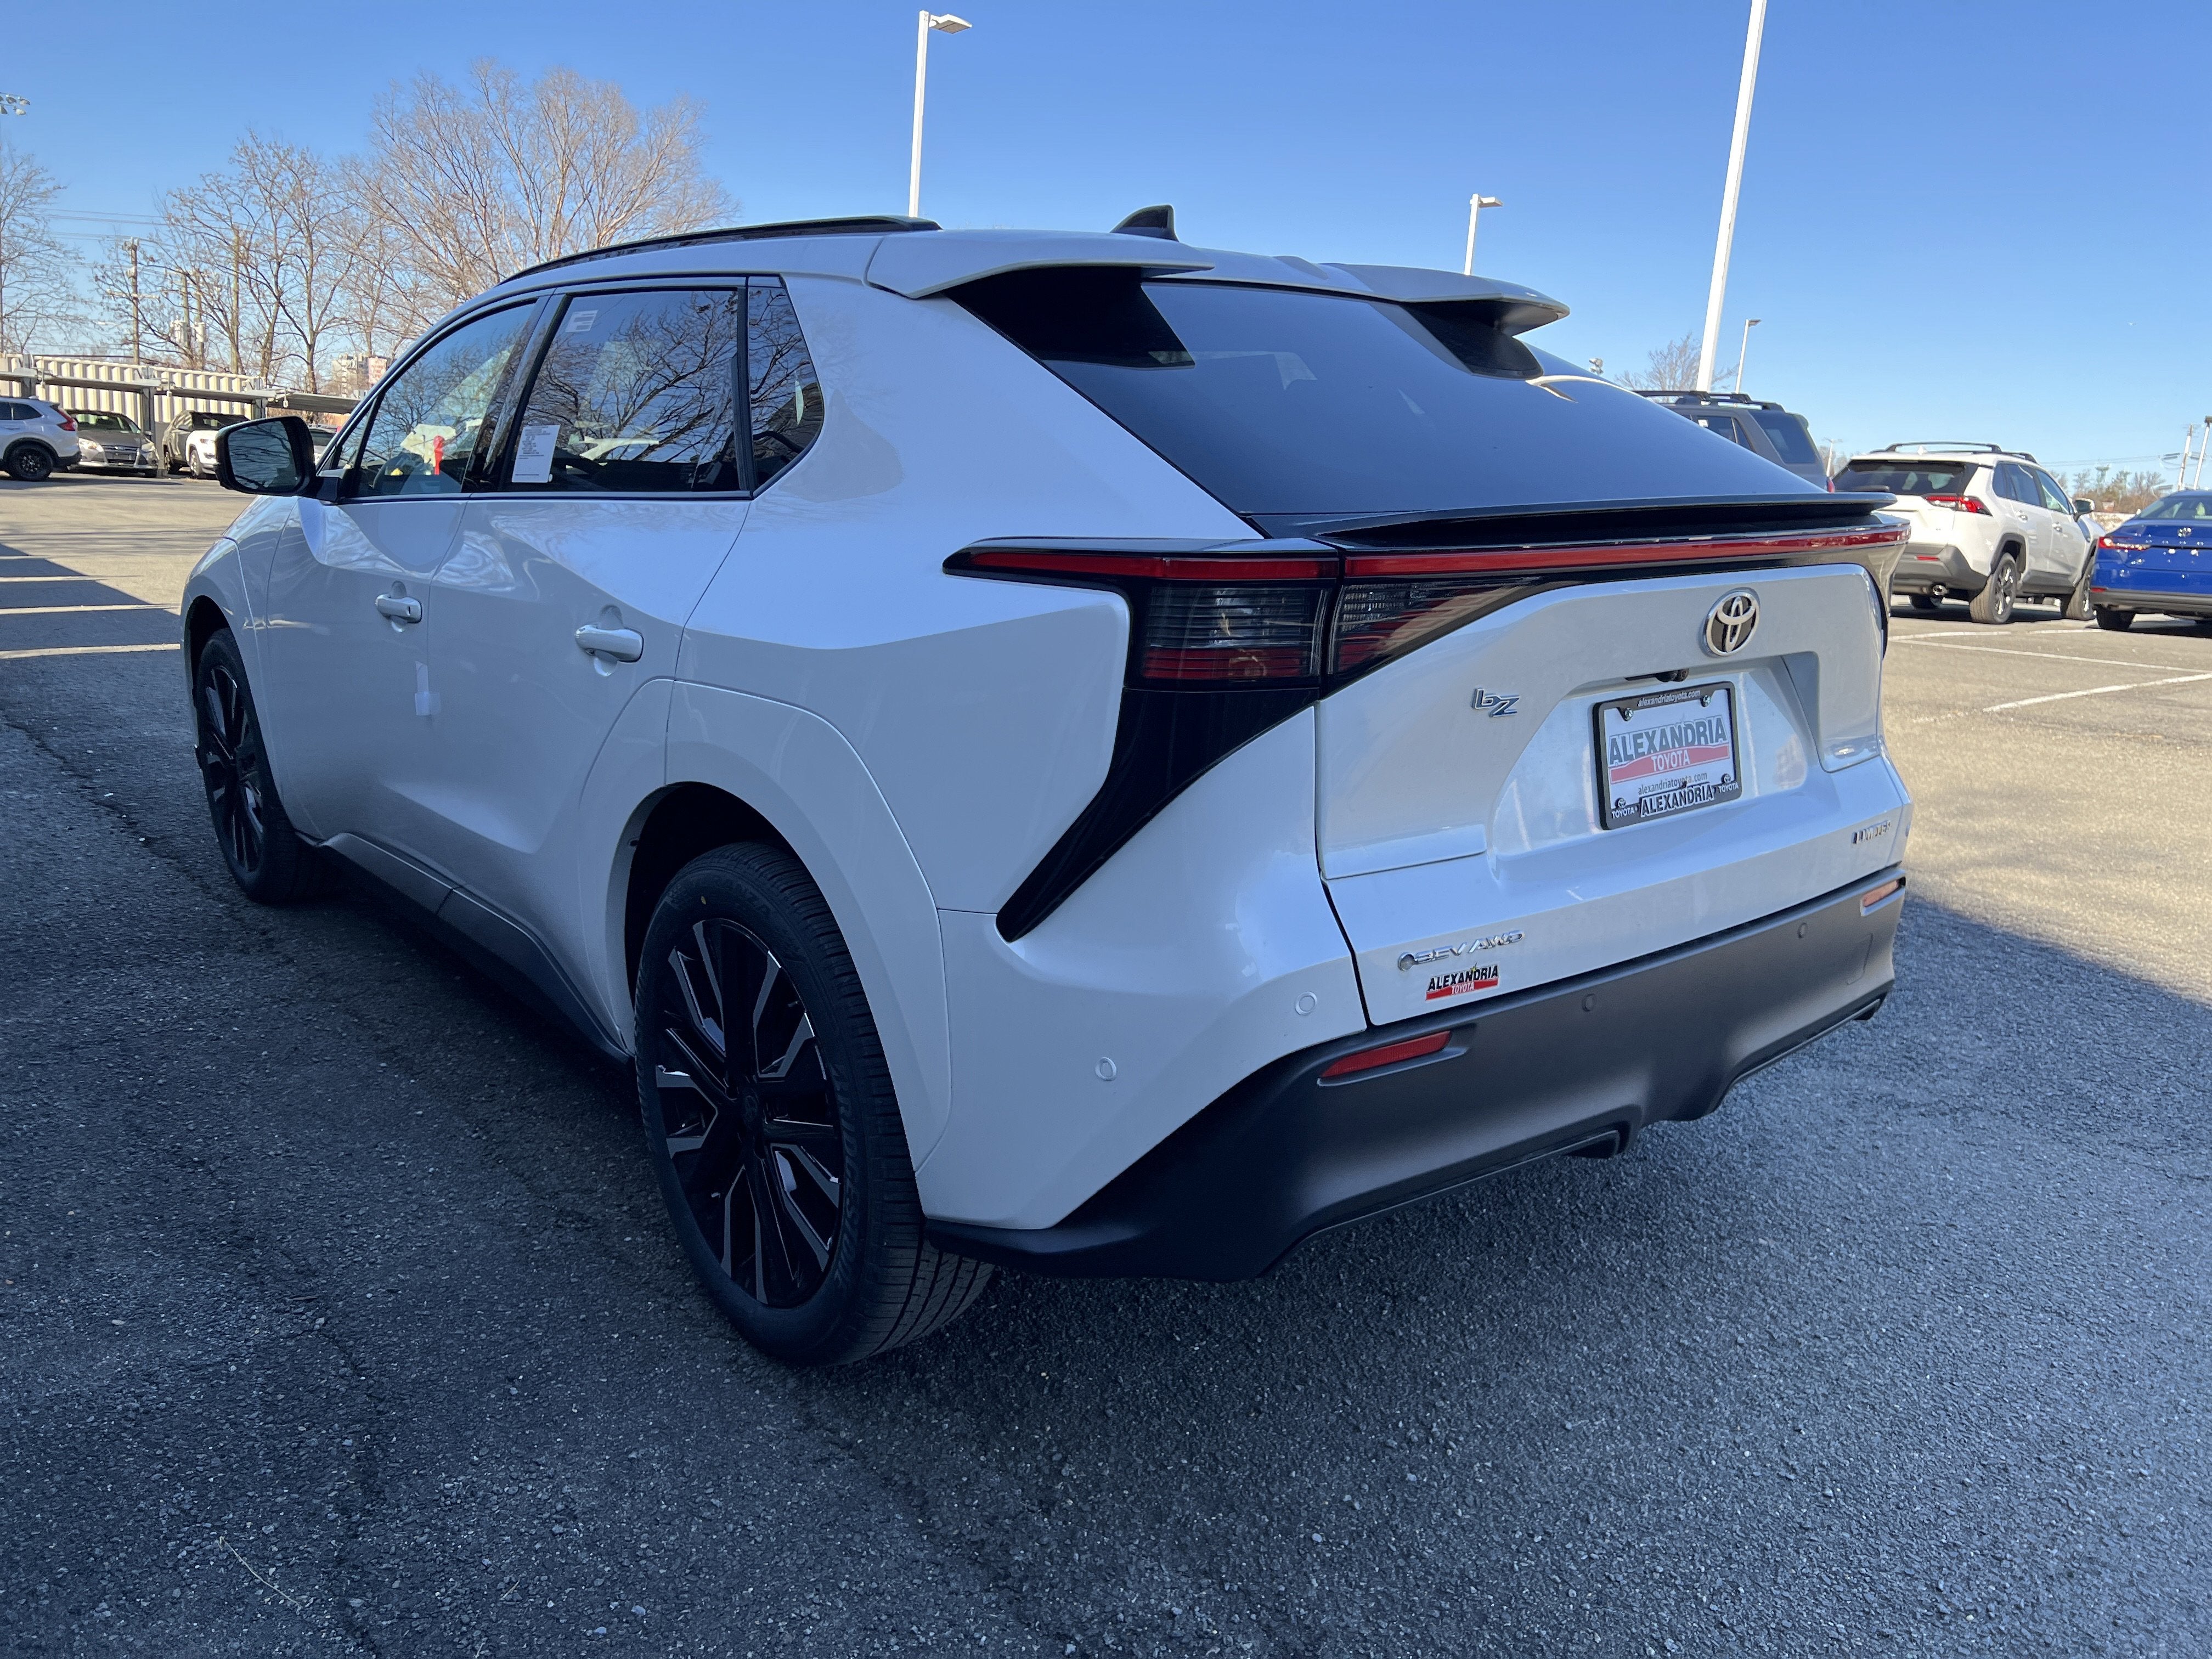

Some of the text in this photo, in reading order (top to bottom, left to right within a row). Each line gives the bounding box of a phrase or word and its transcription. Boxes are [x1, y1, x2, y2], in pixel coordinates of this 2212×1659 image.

[1637, 690, 1700, 707] alexandriatoyota.com
[1609, 716, 1728, 765] ALEXANDRIA
[1651, 749, 1690, 772] TOYOTA
[1638, 772, 1708, 795] alexandriatoyota.com
[1718, 782, 1739, 793] TOYOTA
[1640, 783, 1715, 817] ALEXANDRIA
[1611, 807, 1635, 819] TOYOTA
[1427, 965, 1498, 991] ALEXANDRIA
[1451, 981, 1475, 995] TOYOTA
